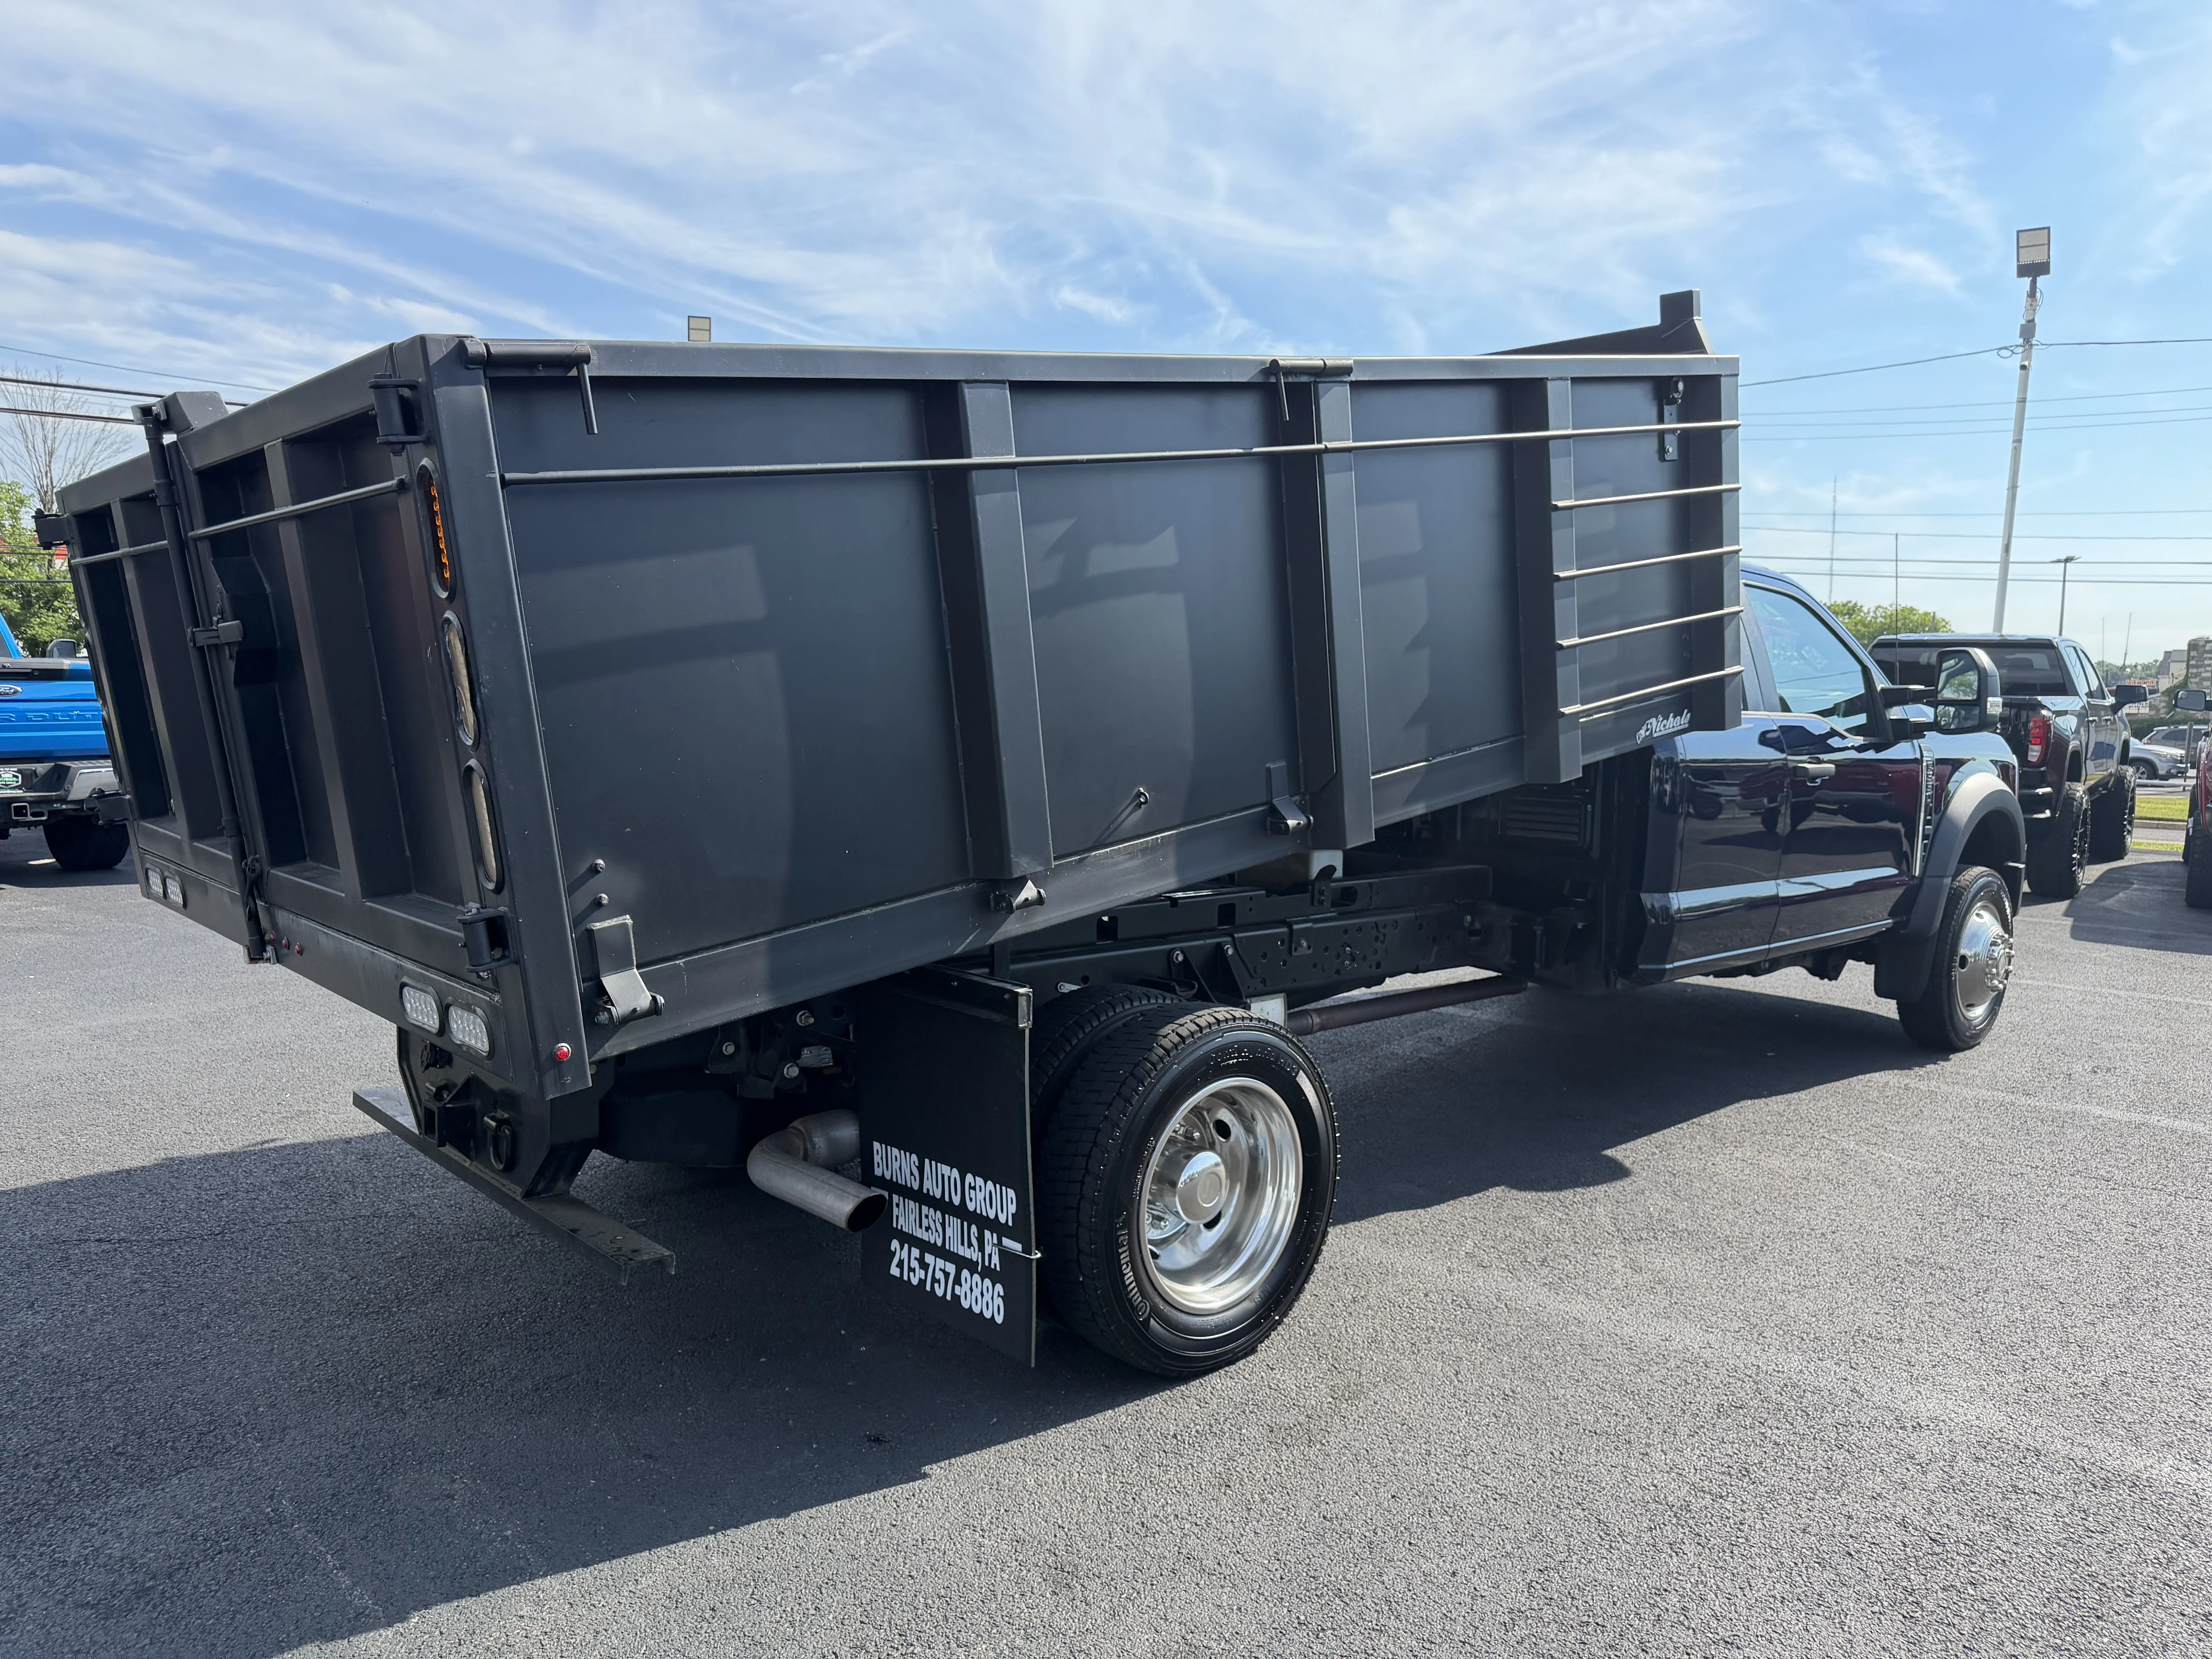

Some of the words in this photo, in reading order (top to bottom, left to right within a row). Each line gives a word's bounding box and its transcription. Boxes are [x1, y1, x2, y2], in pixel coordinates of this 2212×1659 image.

[26, 711, 98, 720] DUT
[873, 1141, 919, 1190] BURNS
[923, 1158, 961, 1206] AUTO
[965, 1173, 1017, 1226] GROUP
[893, 1194, 943, 1247] FAIRLESS
[945, 1214, 982, 1272] HILLS,
[984, 1229, 1000, 1271] PA
[890, 1238, 1005, 1324] 215-757-8886
